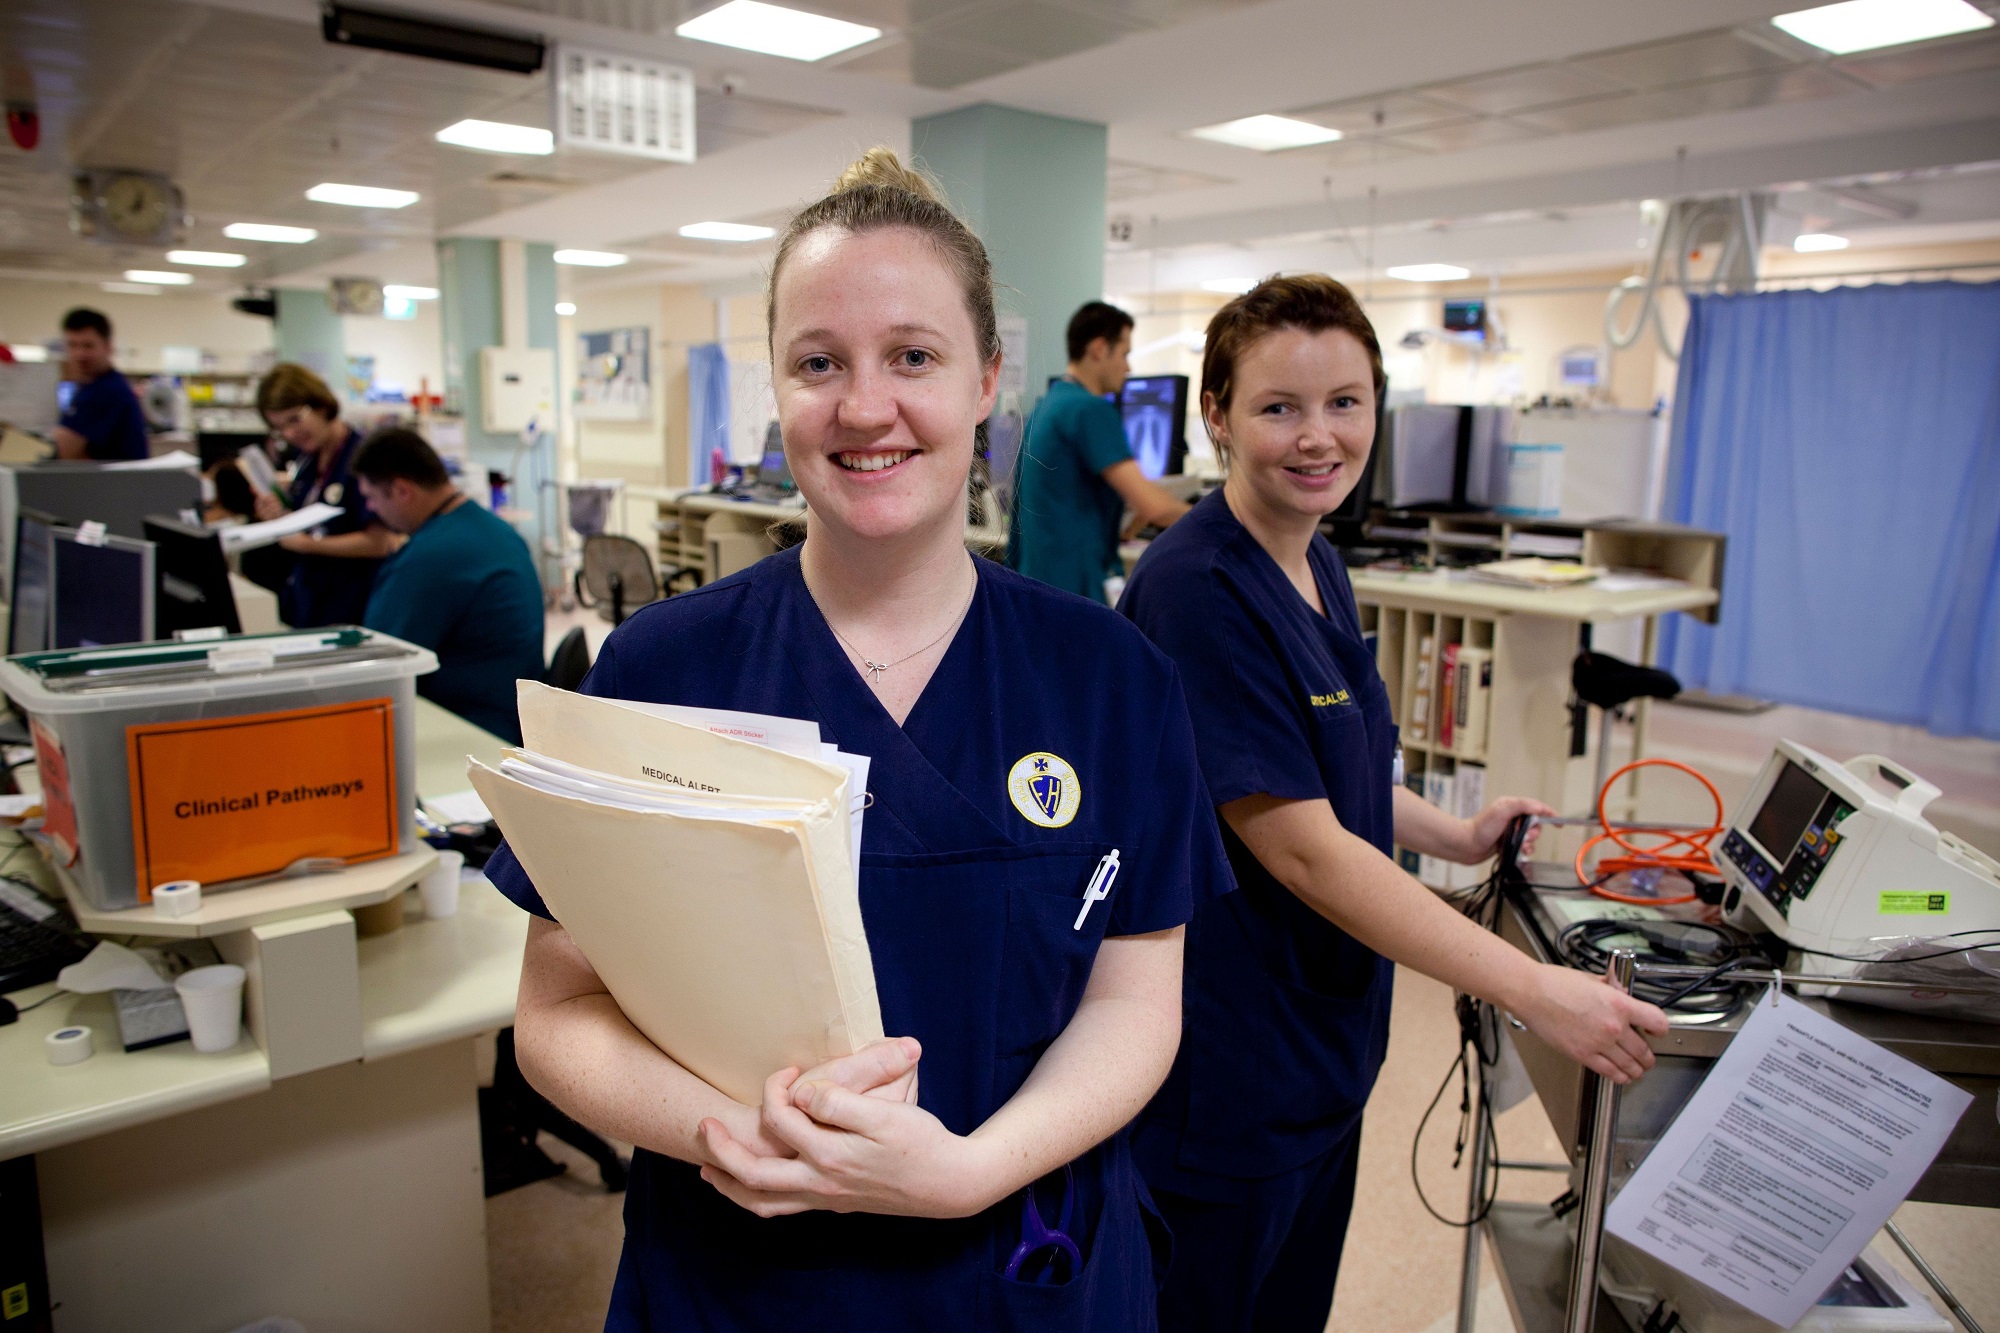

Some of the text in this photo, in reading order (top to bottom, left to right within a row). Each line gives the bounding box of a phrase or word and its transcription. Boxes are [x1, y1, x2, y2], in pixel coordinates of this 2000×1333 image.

[709, 726, 764, 739] Attach ADR Sticker
[642, 765, 721, 794] MEDICAL ALERT
[174, 778, 364, 819] Clinical Pathways
[1908, 1087, 1932, 1103] PRACTICE
